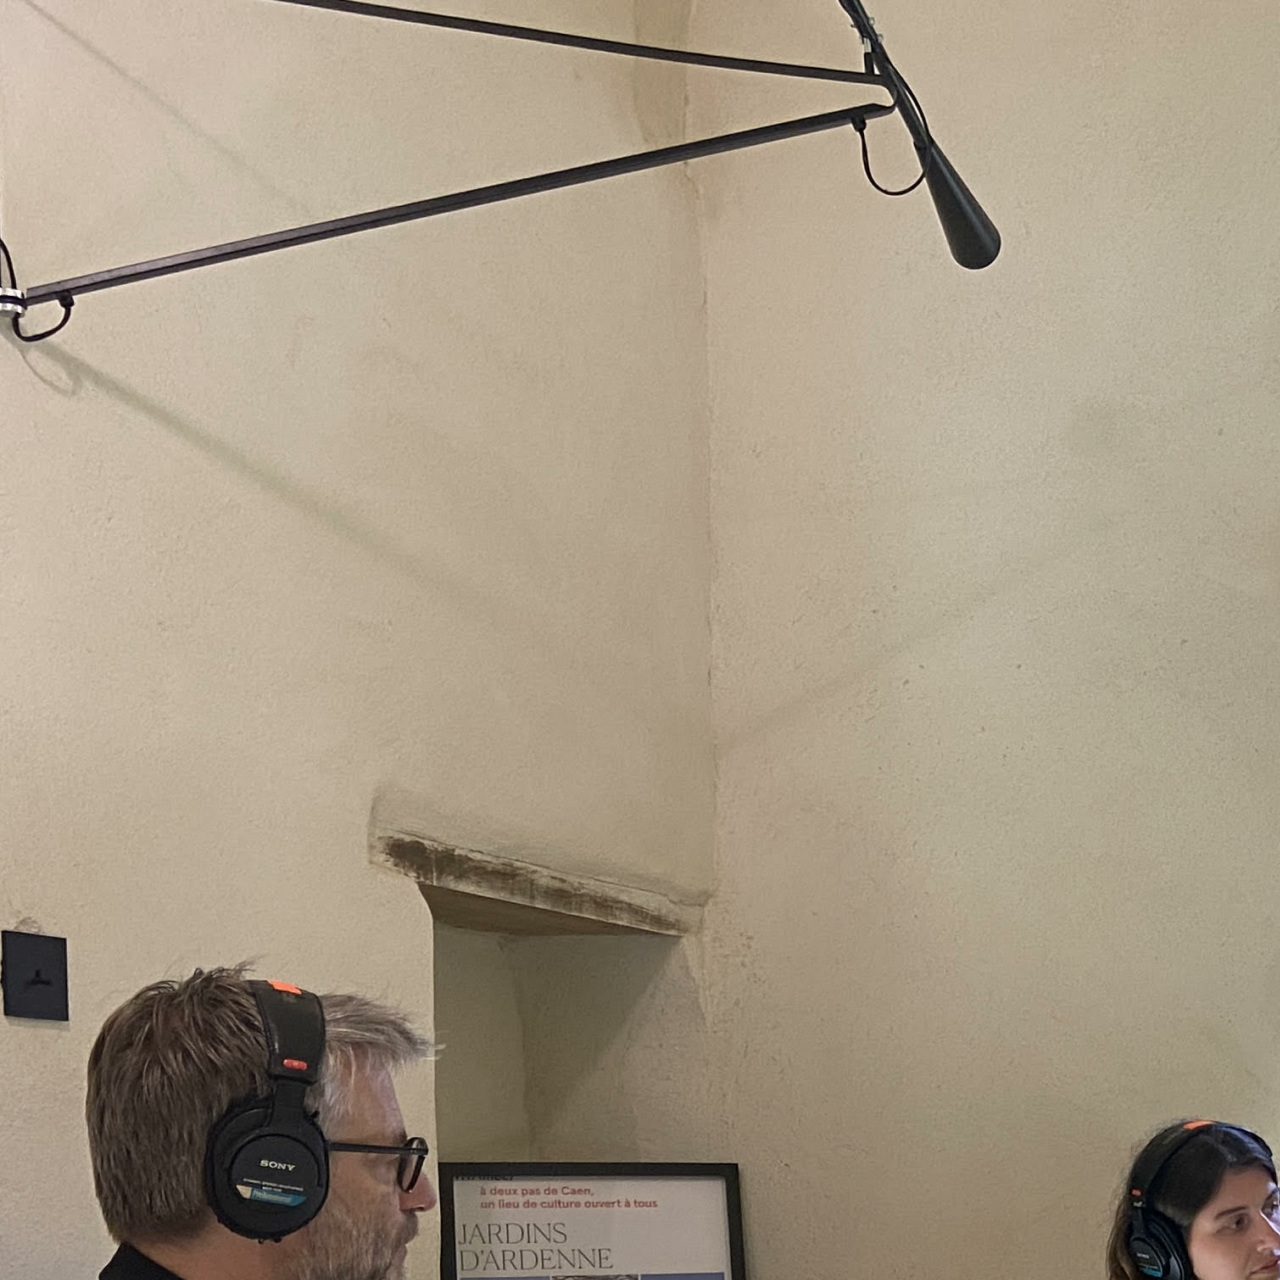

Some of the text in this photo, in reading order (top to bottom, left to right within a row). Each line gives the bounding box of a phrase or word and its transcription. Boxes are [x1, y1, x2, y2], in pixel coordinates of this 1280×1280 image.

[260, 1160, 296, 1171] SONY
[480, 1186, 594, 1197] à deux pas de Caen,
[498, 1199, 520, 1209] lieu
[523, 1199, 537, 1209] de
[540, 1199, 581, 1209] culture
[584, 1200, 622, 1209] ouvert
[624, 1198, 631, 1208] à
[634, 1199, 658, 1208] tous
[458, 1222, 568, 1245] JARDINS
[459, 1248, 614, 1271] D'ARDENNE
